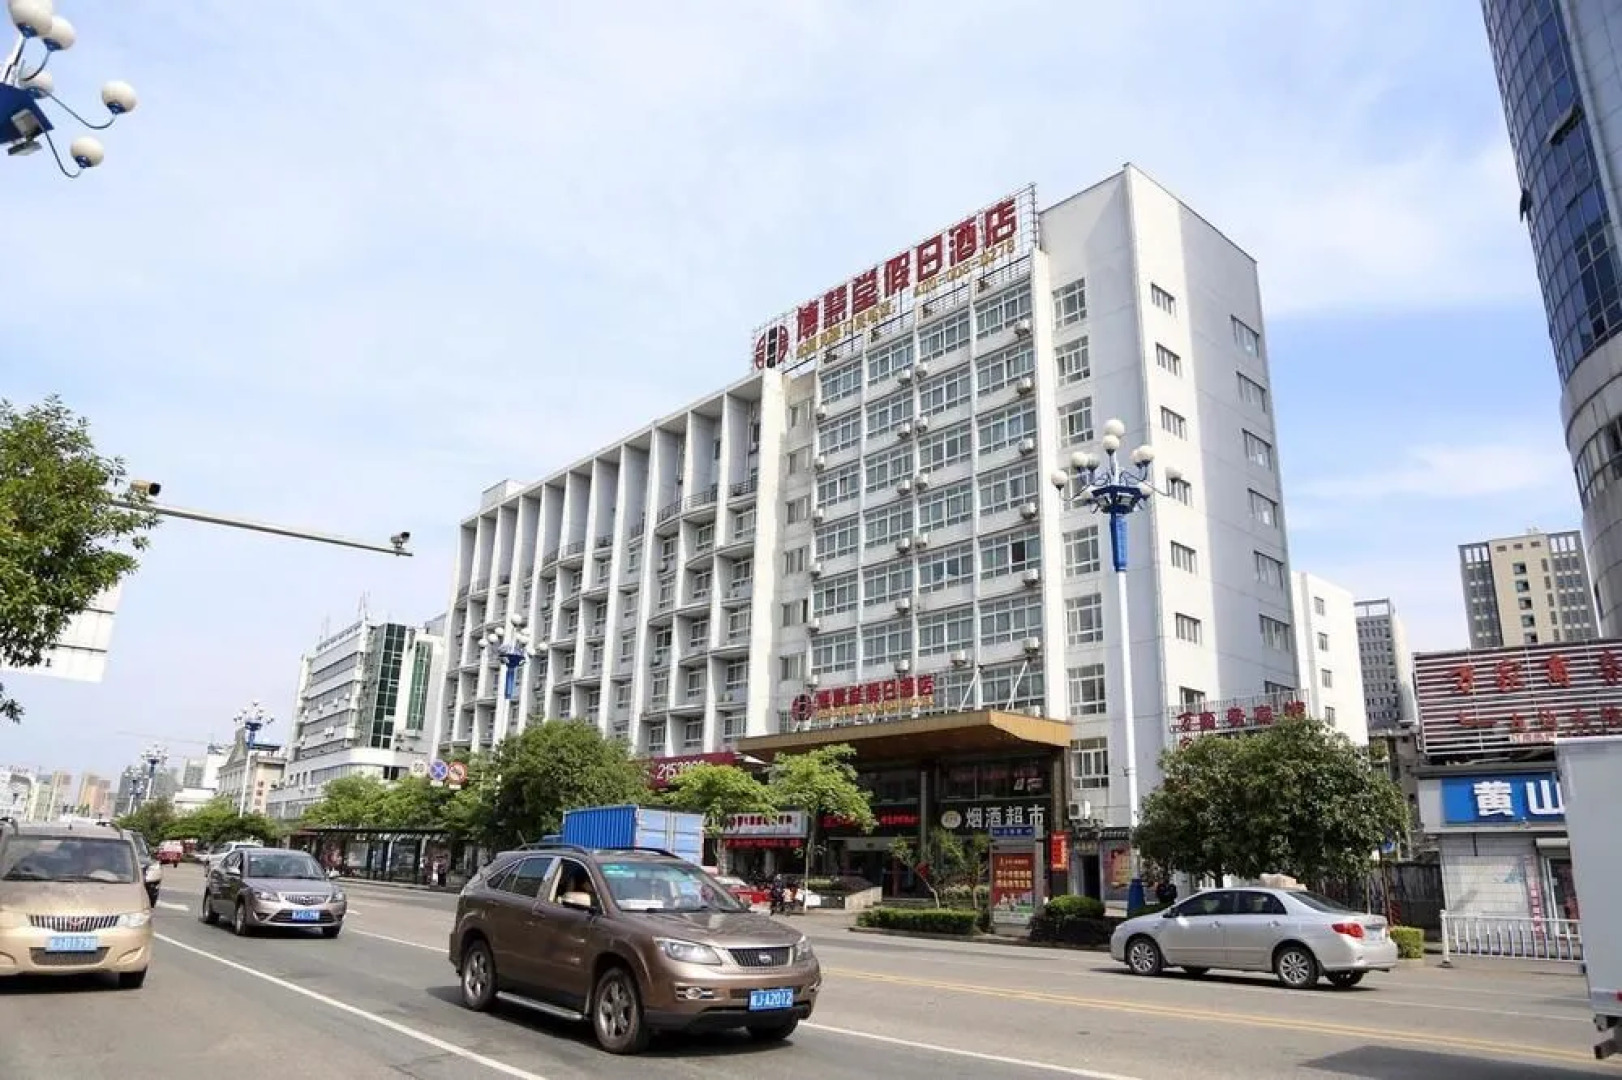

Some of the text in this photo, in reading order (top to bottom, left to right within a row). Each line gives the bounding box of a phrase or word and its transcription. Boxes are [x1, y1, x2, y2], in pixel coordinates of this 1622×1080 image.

[1473, 780, 1565, 817] 黄山
[965, 804, 1045, 828] 烟酒超市
